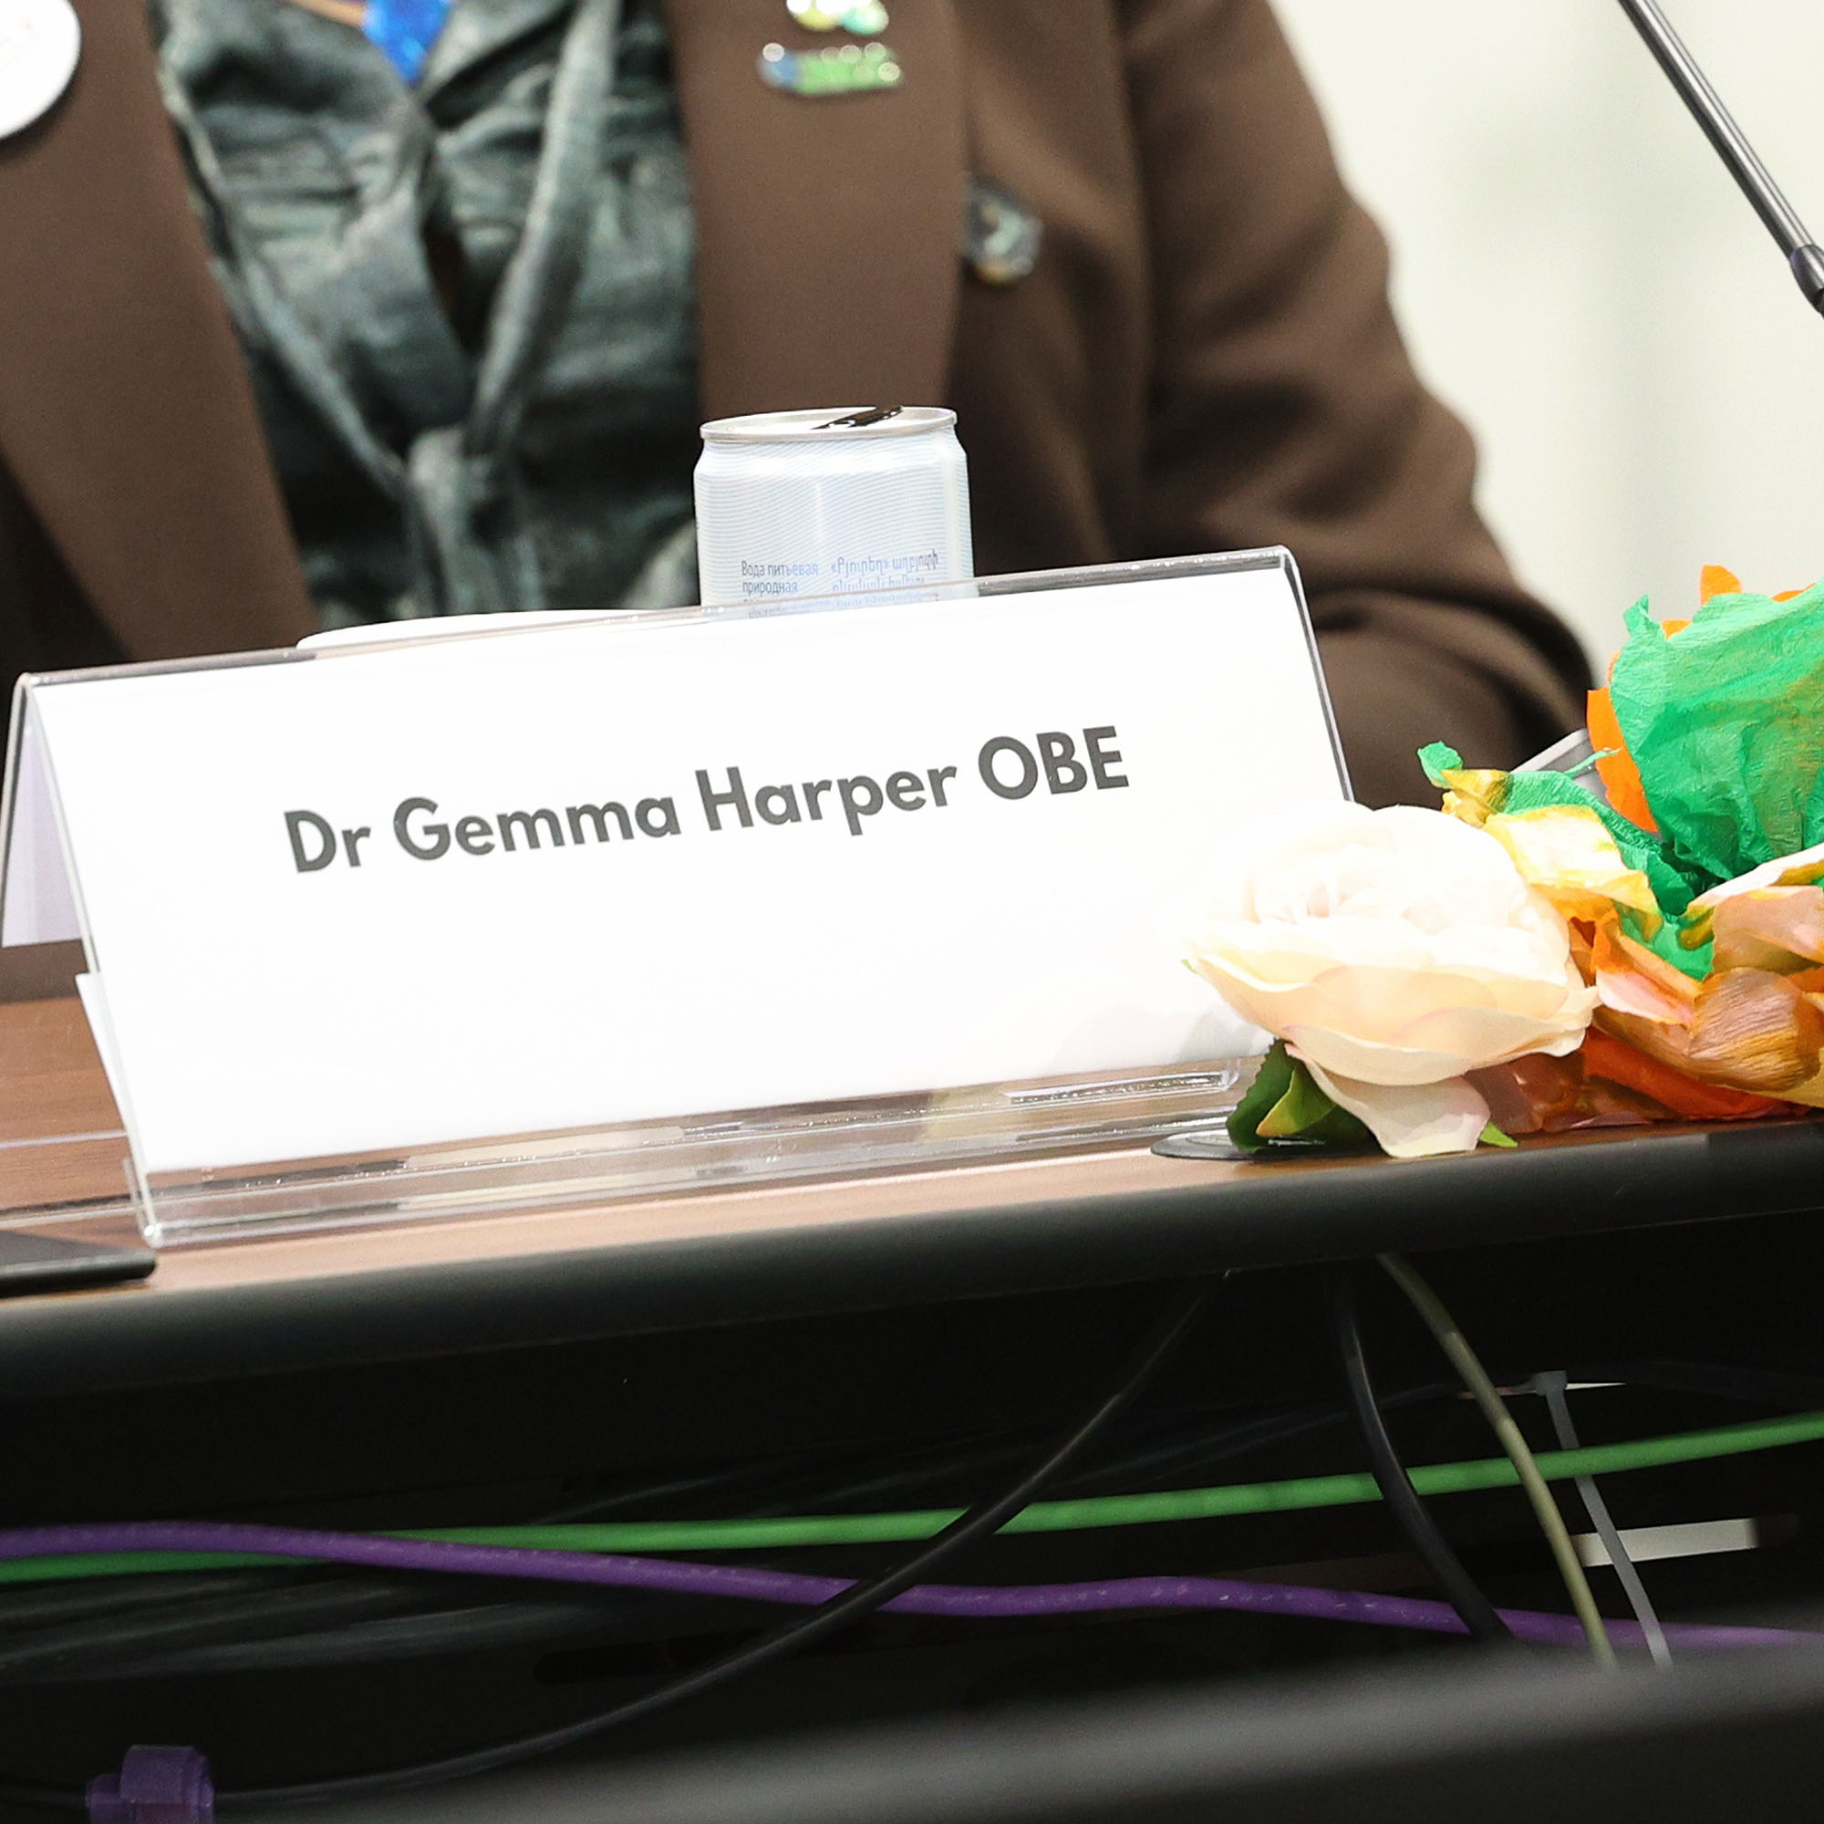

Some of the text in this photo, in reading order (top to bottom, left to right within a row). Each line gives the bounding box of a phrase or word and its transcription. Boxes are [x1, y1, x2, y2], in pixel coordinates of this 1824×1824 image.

[741, 560, 819, 578] Вода питьевая
[742, 581, 798, 597] природная
[283, 725, 1130, 874] Dr Gemma Harper OBE
